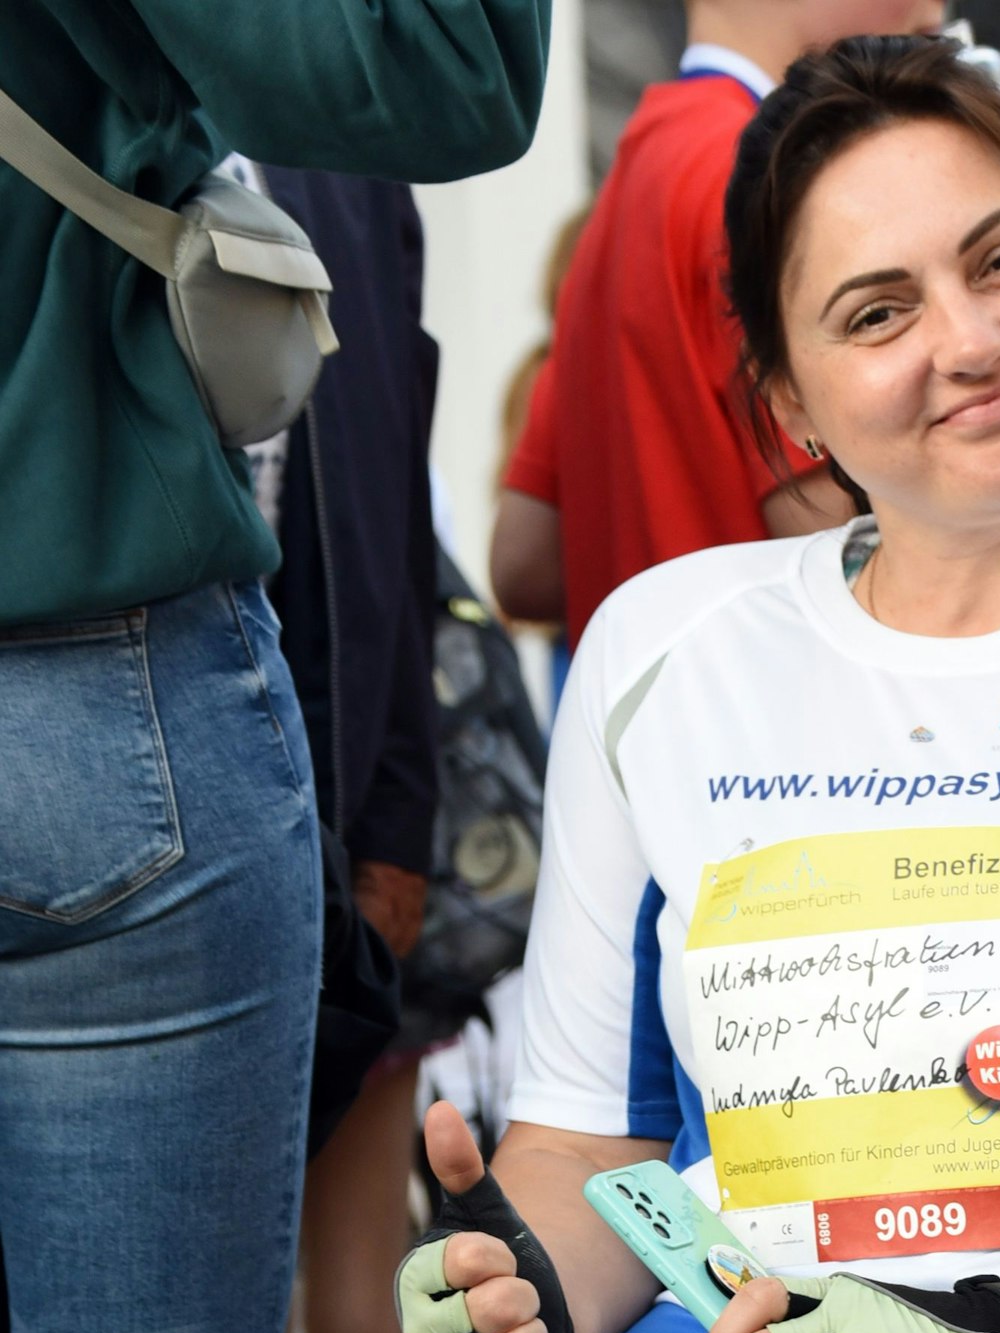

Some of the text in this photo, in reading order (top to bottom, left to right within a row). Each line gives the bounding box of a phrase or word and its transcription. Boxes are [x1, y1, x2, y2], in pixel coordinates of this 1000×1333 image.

[741, 889, 862, 917] wipperfürth
[892, 882, 935, 902] Laufe
[940, 880, 970, 897] und
[975, 881, 1000, 896] tue
[927, 964, 949, 974] 9089
[919, 990, 991, 1019] e.V.
[723, 1153, 836, 1177] Gewaltprävention
[840, 1146, 861, 1163] für
[866, 1143, 919, 1160] Kinder
[925, 1139, 956, 1156] und
[818, 1212, 832, 1247] 9089
[874, 1202, 967, 1242] 9089
